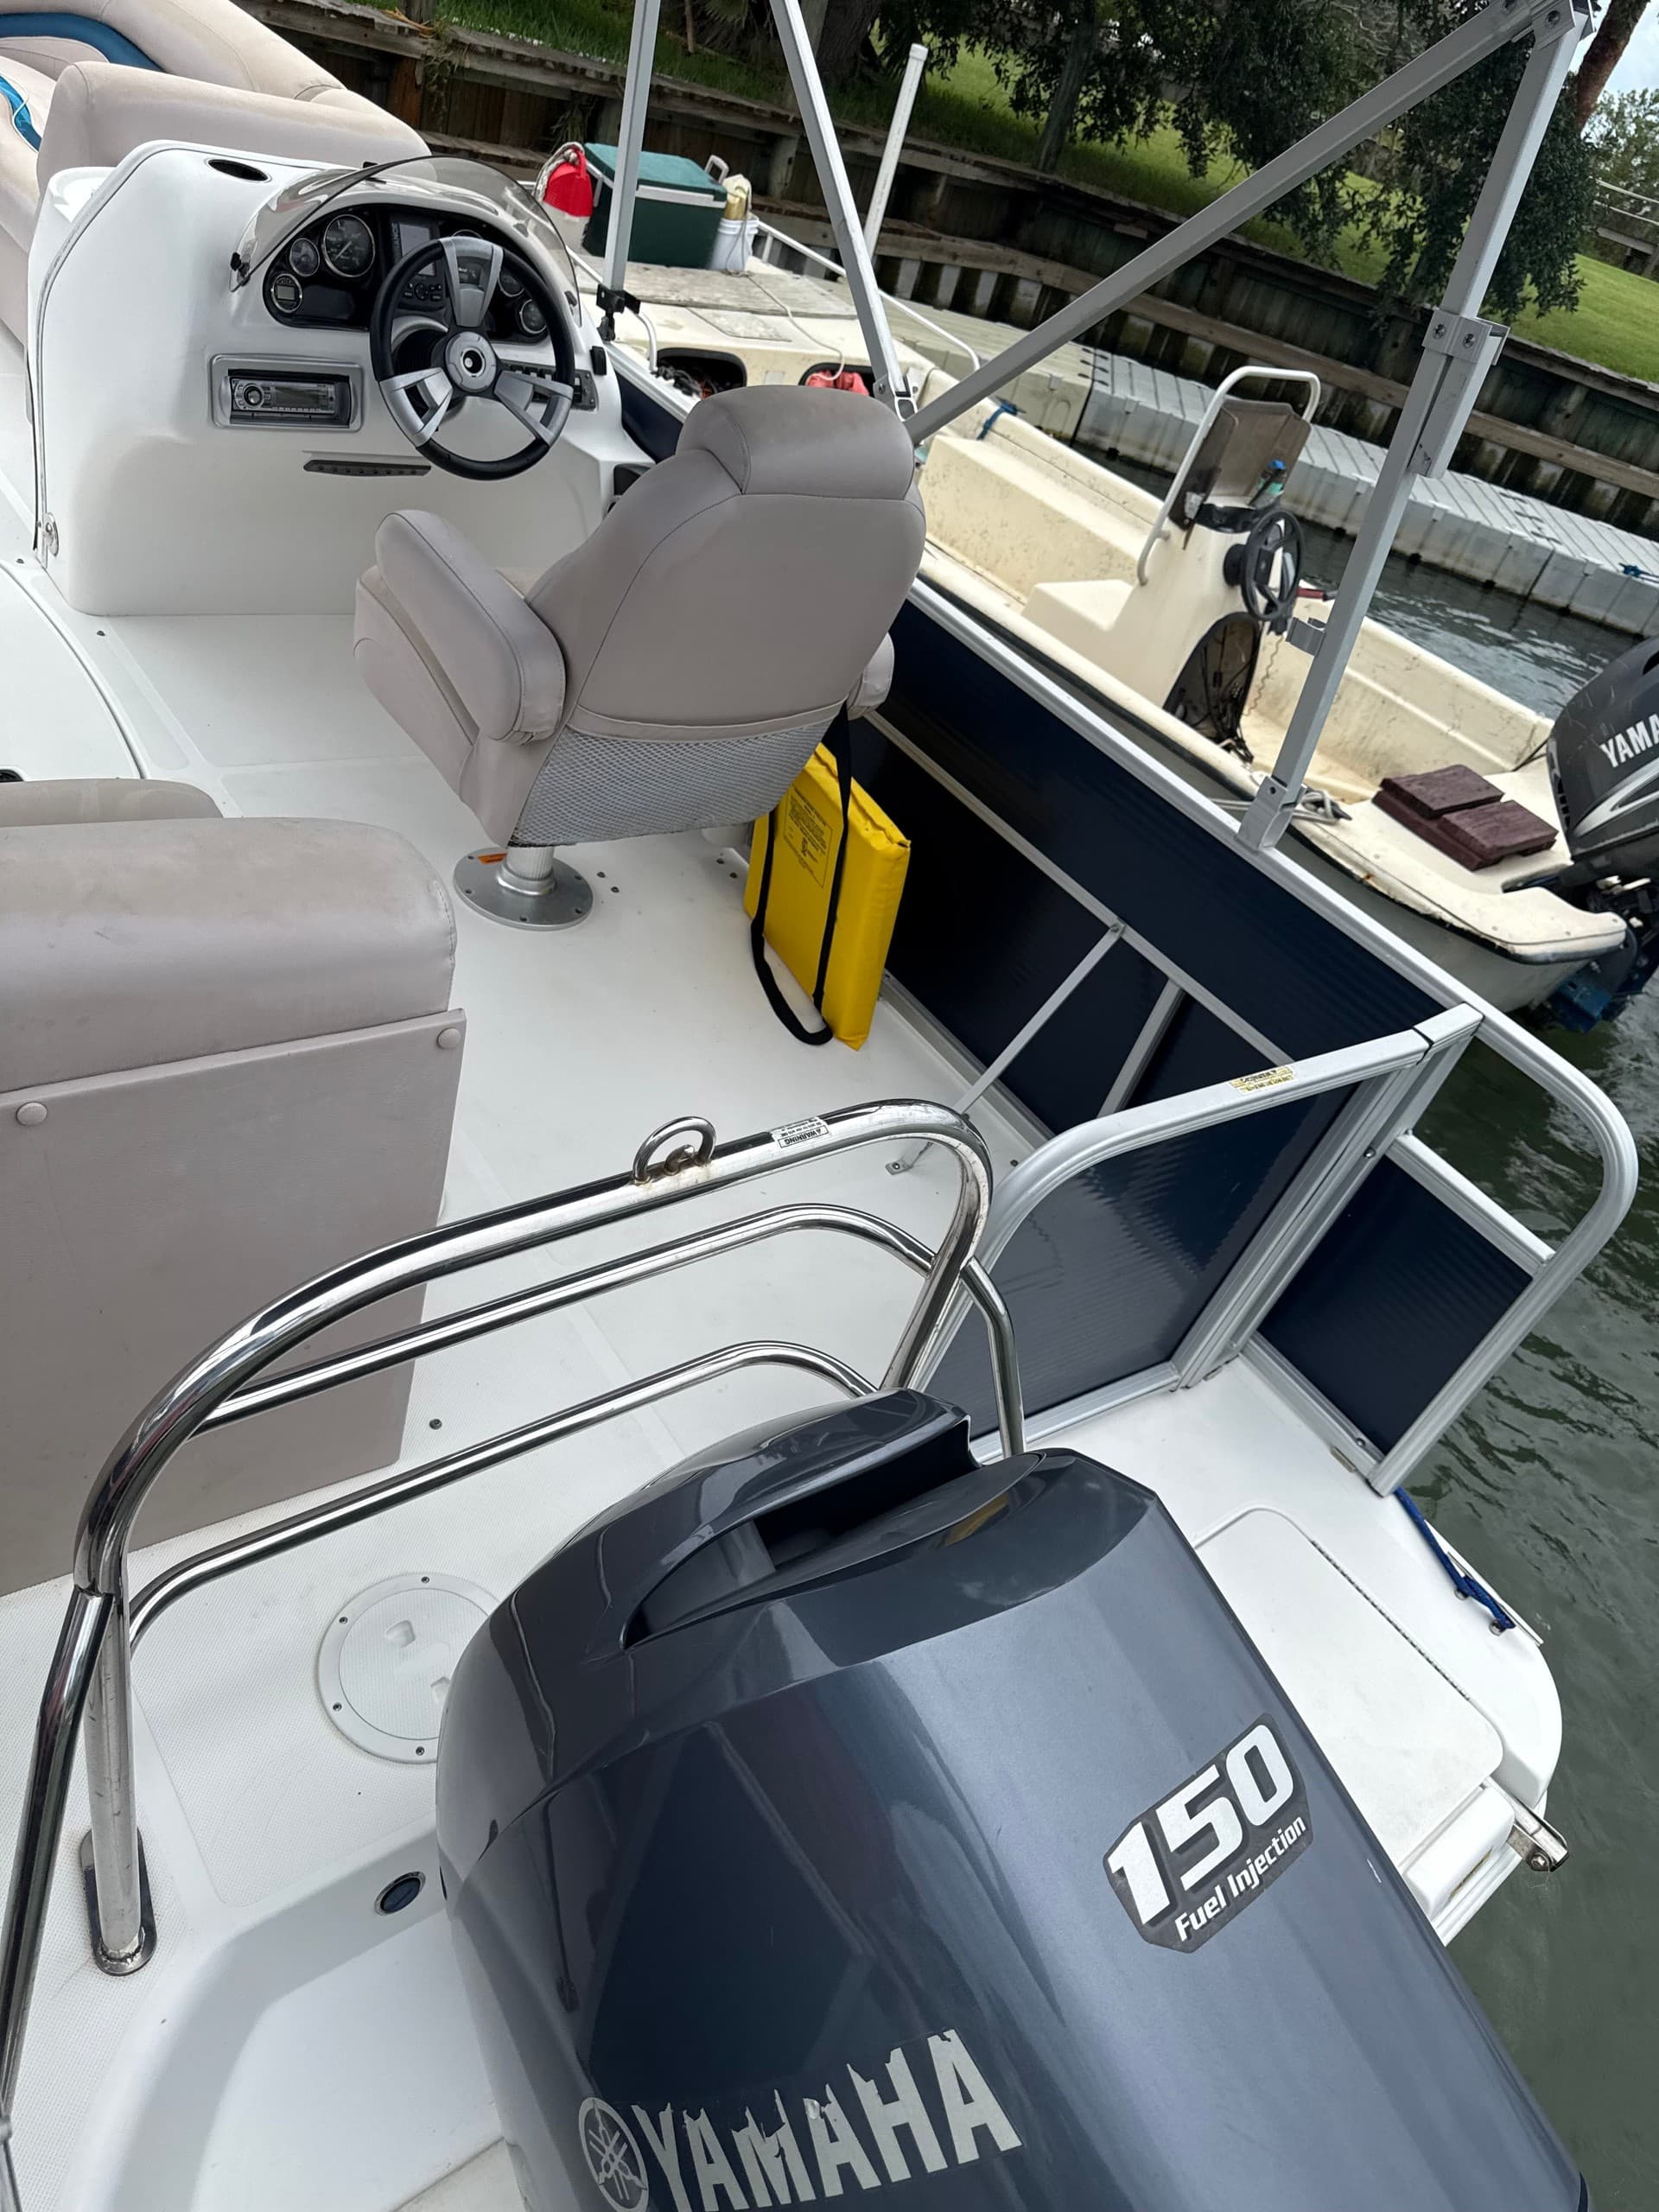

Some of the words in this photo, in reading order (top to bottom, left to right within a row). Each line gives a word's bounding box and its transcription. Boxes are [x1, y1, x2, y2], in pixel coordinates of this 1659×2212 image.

[784, 1129, 817, 1145] WARNING
[1108, 1725, 1294, 1925] 150
[1175, 1885, 1227, 1942] Fuel
[1227, 1816, 1306, 1897] Injection
[631, 2029, 1022, 2212] YAMAHA
